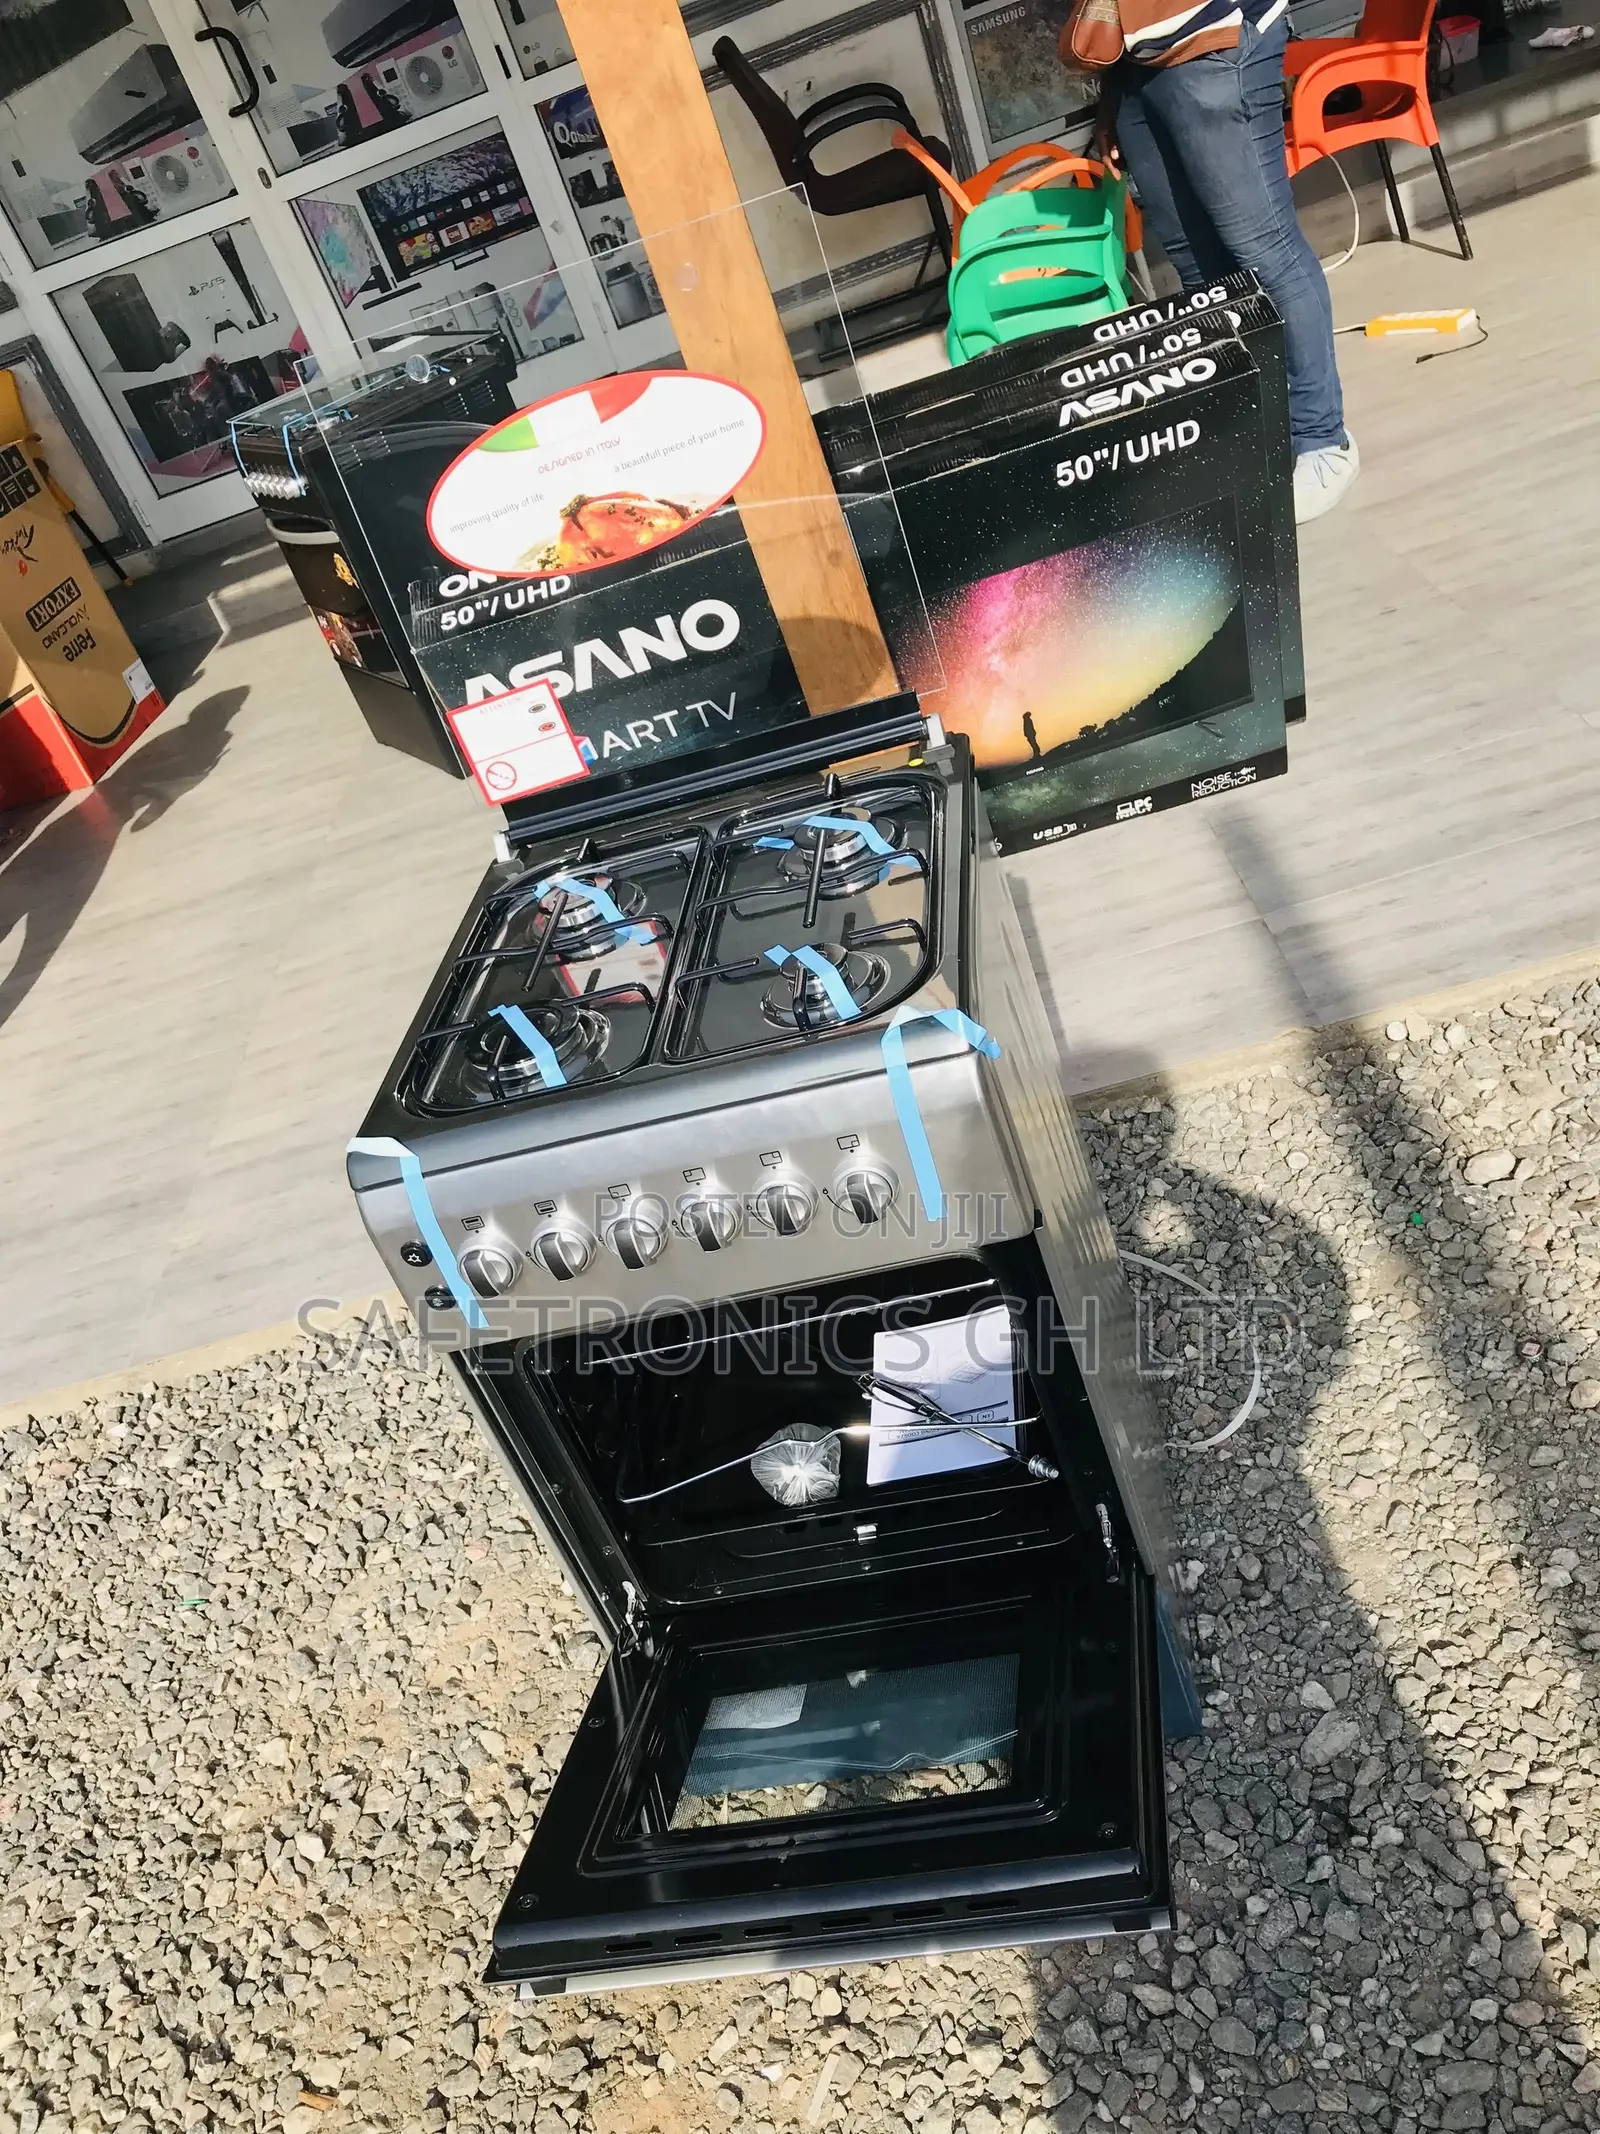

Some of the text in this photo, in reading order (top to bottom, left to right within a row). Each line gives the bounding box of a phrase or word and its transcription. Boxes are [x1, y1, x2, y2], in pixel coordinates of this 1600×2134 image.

[970, 6, 1026, 36] SAMSUNG
[448, 58, 459, 69] LG
[192, 159, 203, 168] LG
[200, 275, 226, 292] PS5
[1059, 358, 1217, 428] ASANO
[621, 448, 661, 470] beautifull
[662, 440, 686, 457] piece
[687, 434, 697, 446] of
[698, 429, 718, 444] your
[719, 418, 745, 434] home
[537, 450, 583, 475] DESIGNED
[584, 446, 596, 458] IN
[449, 491, 545, 534] improving quality of life
[28, 580, 80, 630] EXPORT
[42, 611, 84, 649] VOLCANO
[62, 628, 97, 662] Ferre
[465, 598, 741, 705] ASANO
[686, 691, 738, 729] TV
[1190, 771, 1232, 793] NOISE
[1191, 772, 1257, 798] REDUCTION
[1134, 795, 1153, 809] PC
[1032, 825, 1063, 841] USB
